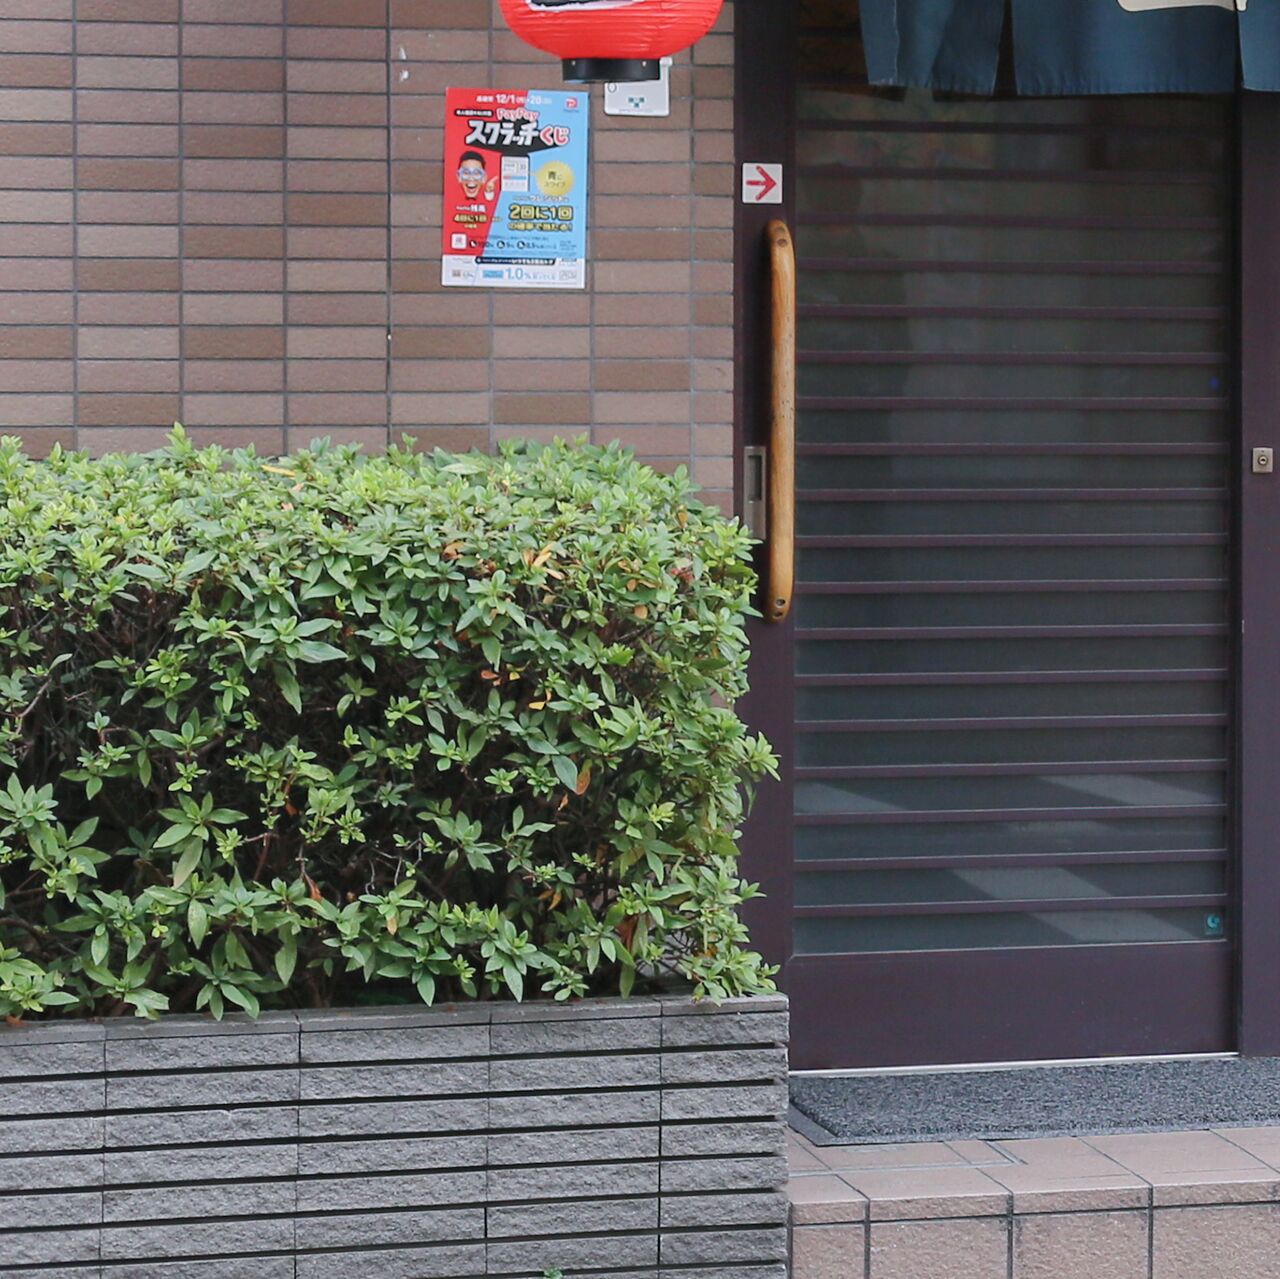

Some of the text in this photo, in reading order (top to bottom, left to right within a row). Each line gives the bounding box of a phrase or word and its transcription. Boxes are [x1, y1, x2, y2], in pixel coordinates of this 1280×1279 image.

[496, 107, 540, 121] PayPay
[466, 120, 570, 145] スクラッチくじ
[508, 204, 574, 221] 2回に1回
